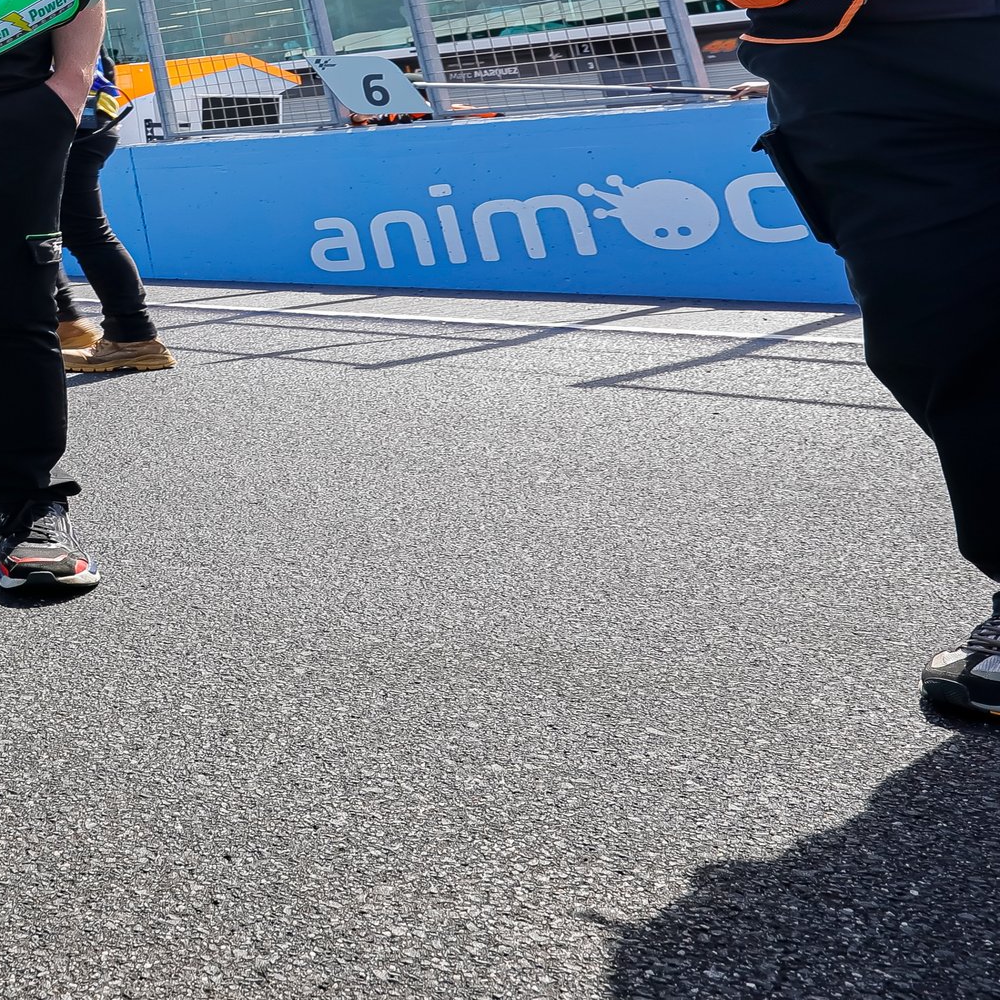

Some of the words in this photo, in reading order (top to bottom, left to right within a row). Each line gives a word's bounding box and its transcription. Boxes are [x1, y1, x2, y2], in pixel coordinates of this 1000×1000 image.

[581, 43, 590, 53] 2
[474, 66, 519, 79] MARQUEZ
[362, 73, 391, 107] 6
